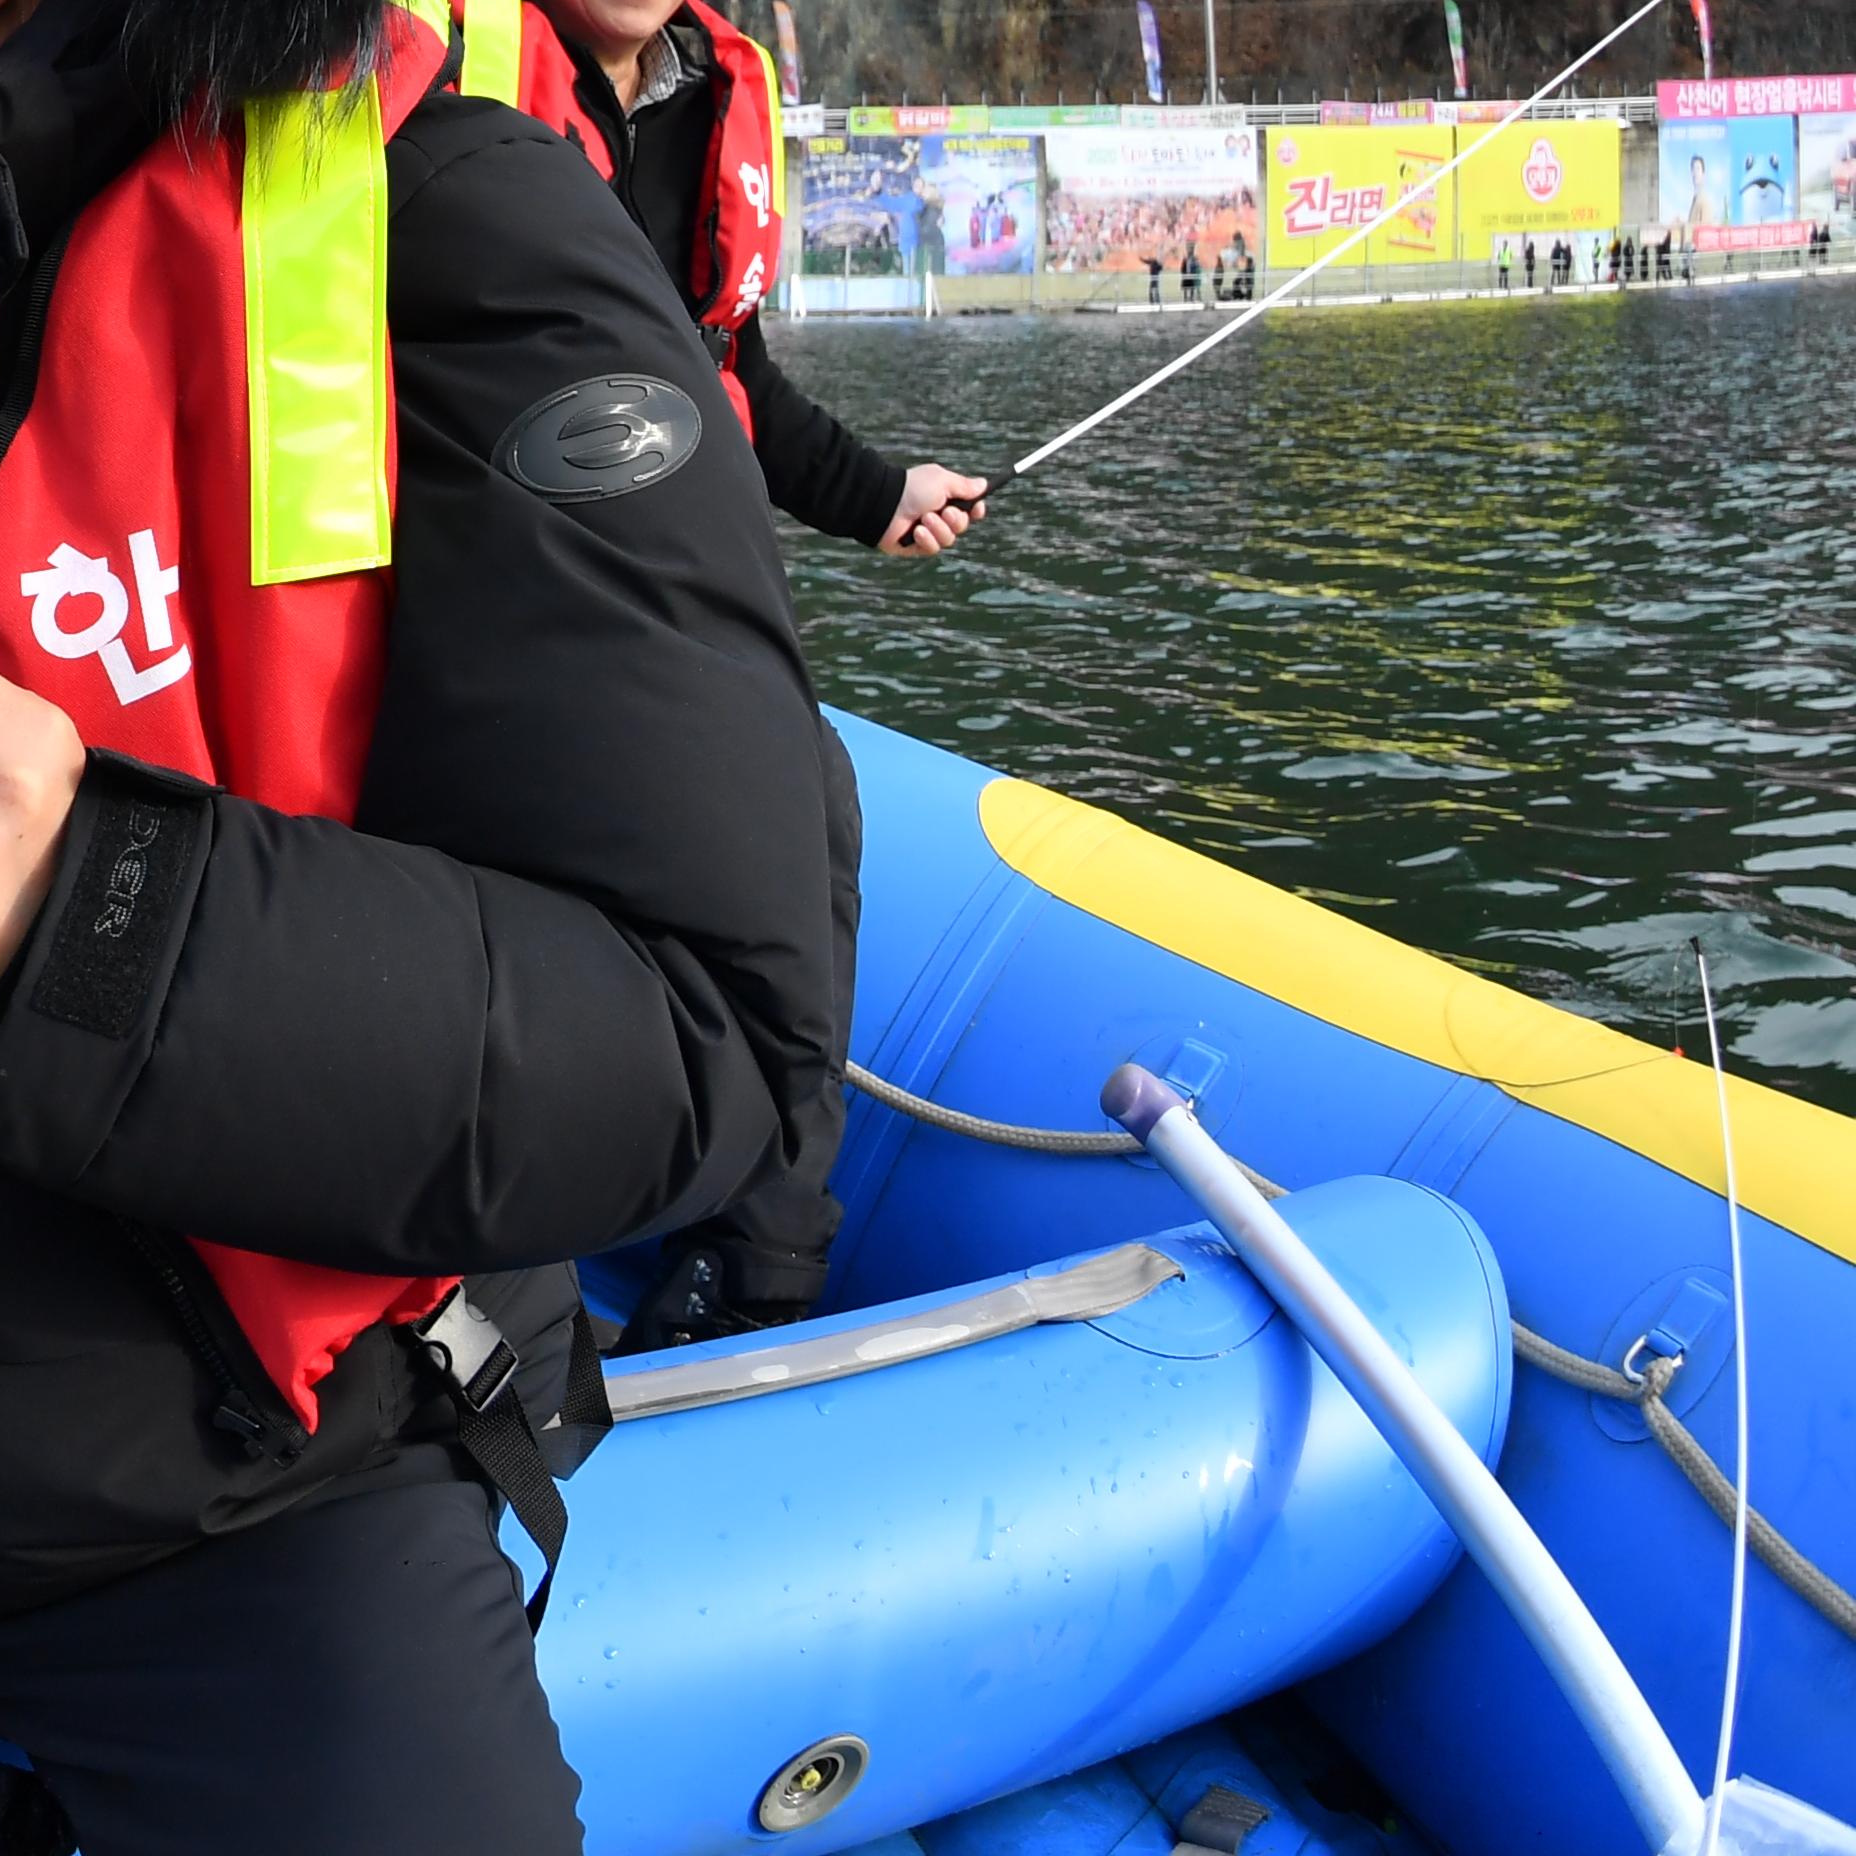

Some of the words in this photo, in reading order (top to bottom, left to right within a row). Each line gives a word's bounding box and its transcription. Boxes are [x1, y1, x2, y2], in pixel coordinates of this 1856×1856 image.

[1676, 82, 1728, 117] 산천어
[1284, 175, 1385, 234] 진라면
[20, 528, 192, 706] 한
